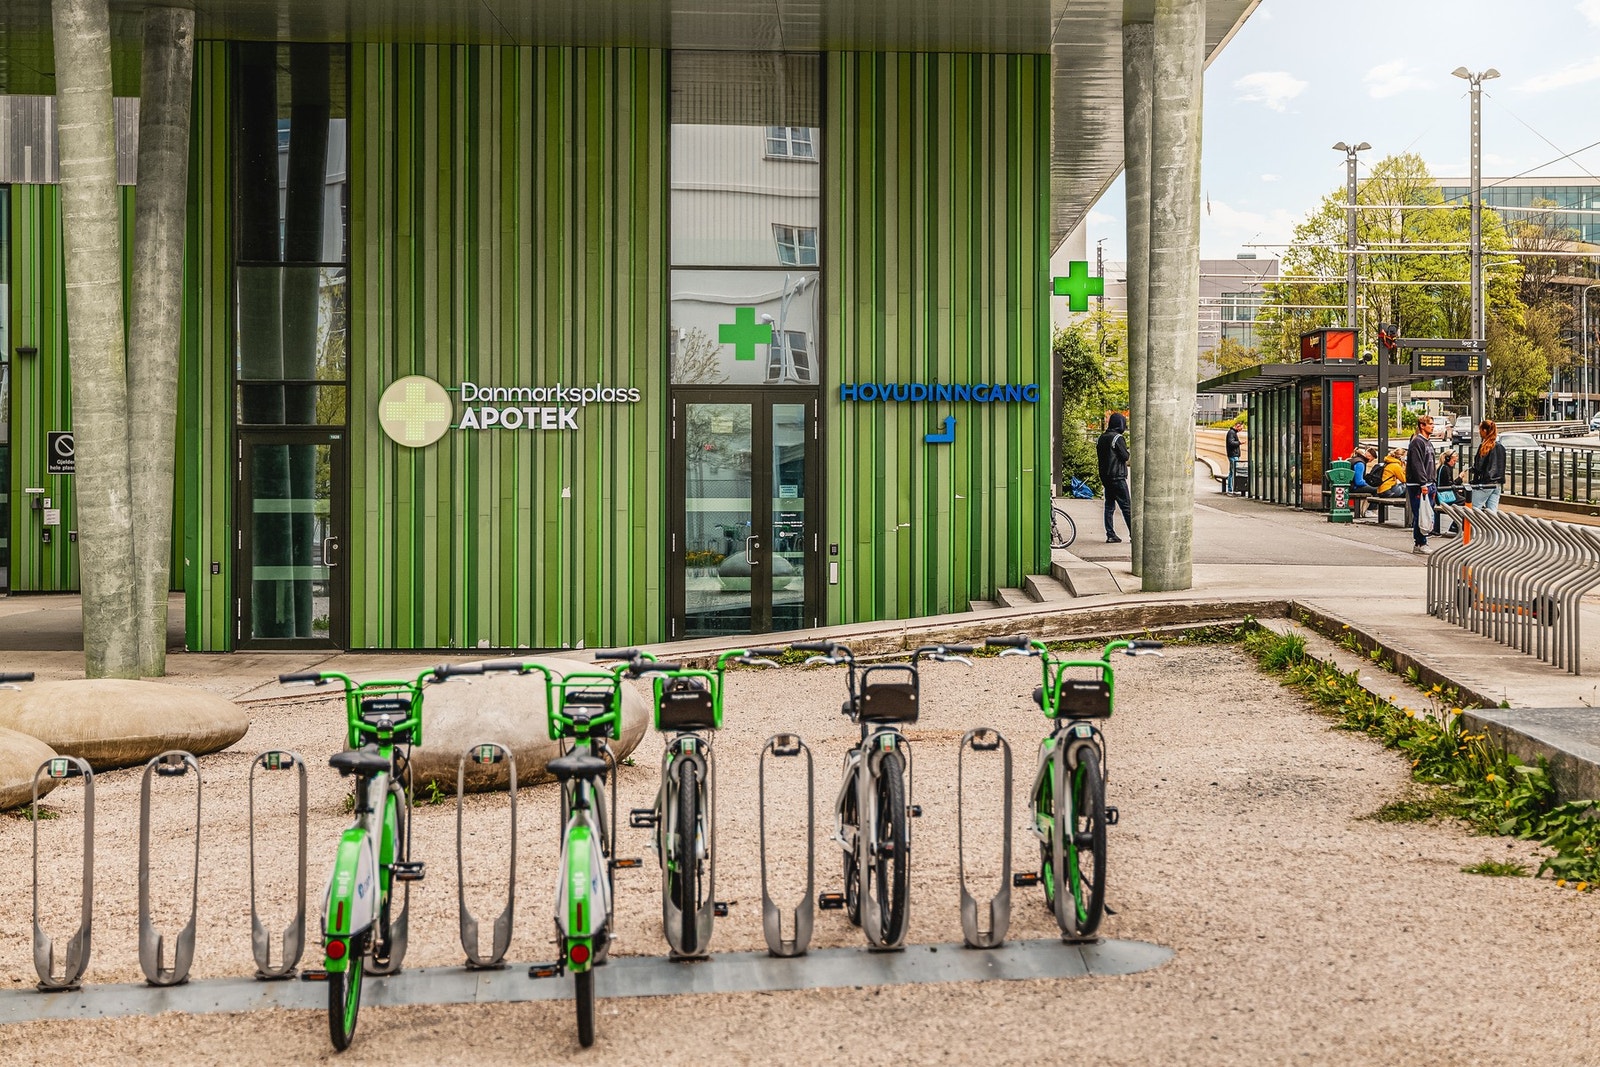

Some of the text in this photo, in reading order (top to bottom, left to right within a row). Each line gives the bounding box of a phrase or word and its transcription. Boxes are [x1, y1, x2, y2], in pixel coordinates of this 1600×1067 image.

[461, 382, 641, 406] Danmarksplass
[840, 382, 1040, 403] HOVUDINNGANG
[459, 406, 579, 430] APOTEK
